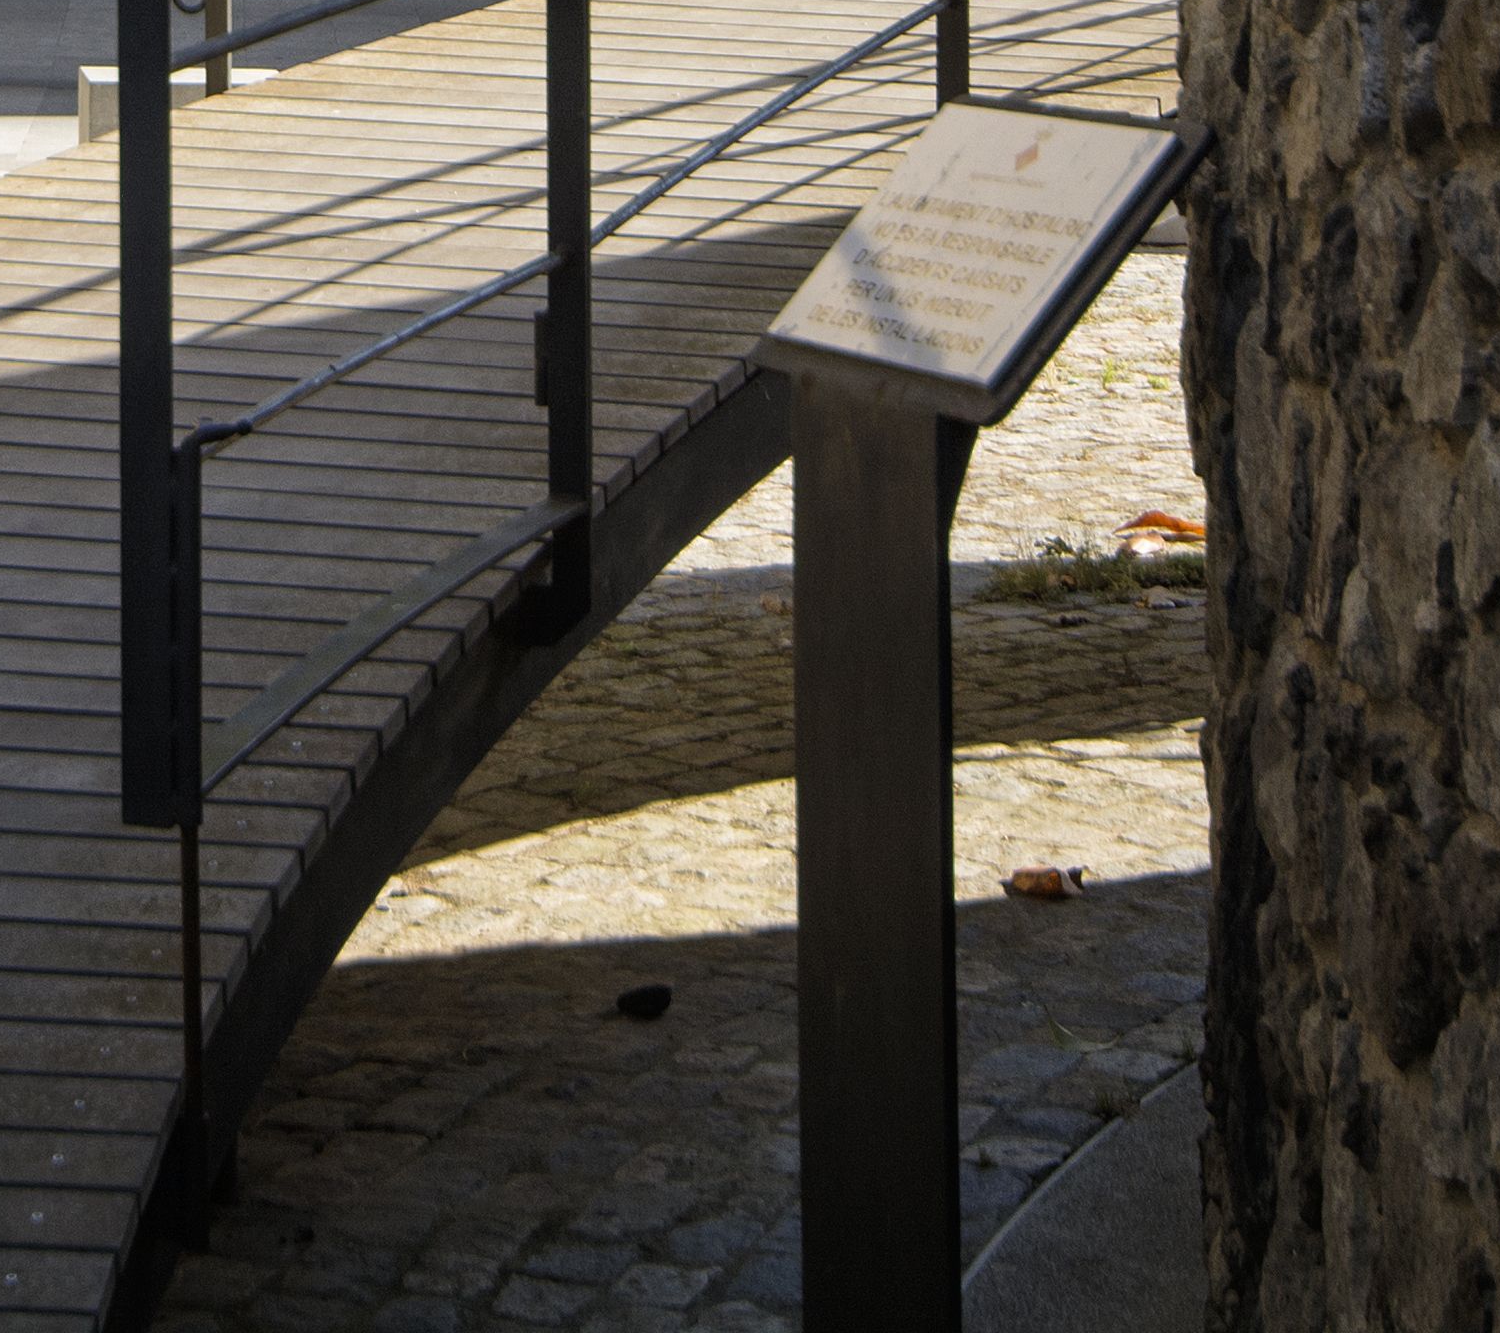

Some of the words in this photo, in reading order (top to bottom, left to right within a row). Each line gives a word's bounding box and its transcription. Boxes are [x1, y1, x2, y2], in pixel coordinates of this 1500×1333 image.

[842, 277, 877, 298] PER
[873, 284, 900, 303] UN
[806, 302, 833, 322] DE
[828, 307, 863, 328] LES
